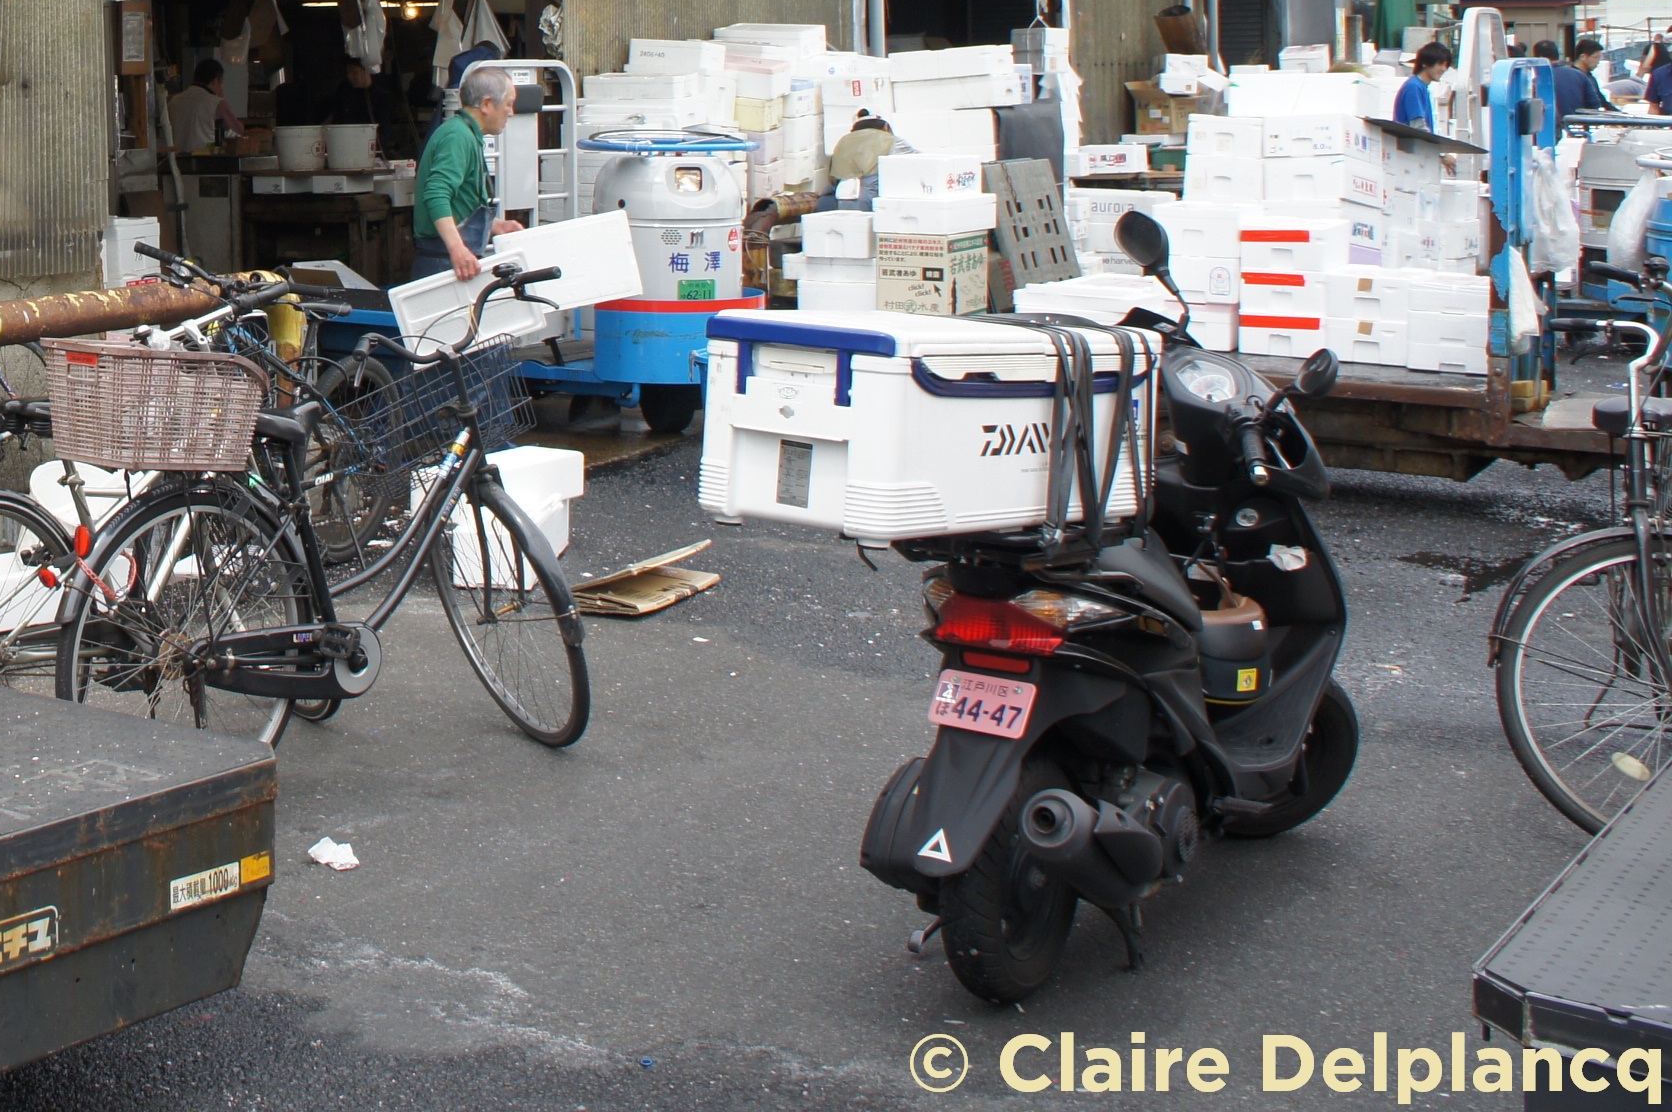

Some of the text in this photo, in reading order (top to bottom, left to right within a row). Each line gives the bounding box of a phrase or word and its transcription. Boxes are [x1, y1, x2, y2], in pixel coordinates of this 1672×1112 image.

[668, 251, 721, 273] 梅澤
[963, 678, 1009, 697] 江戸川区
[951, 697, 1023, 730] 44-47
